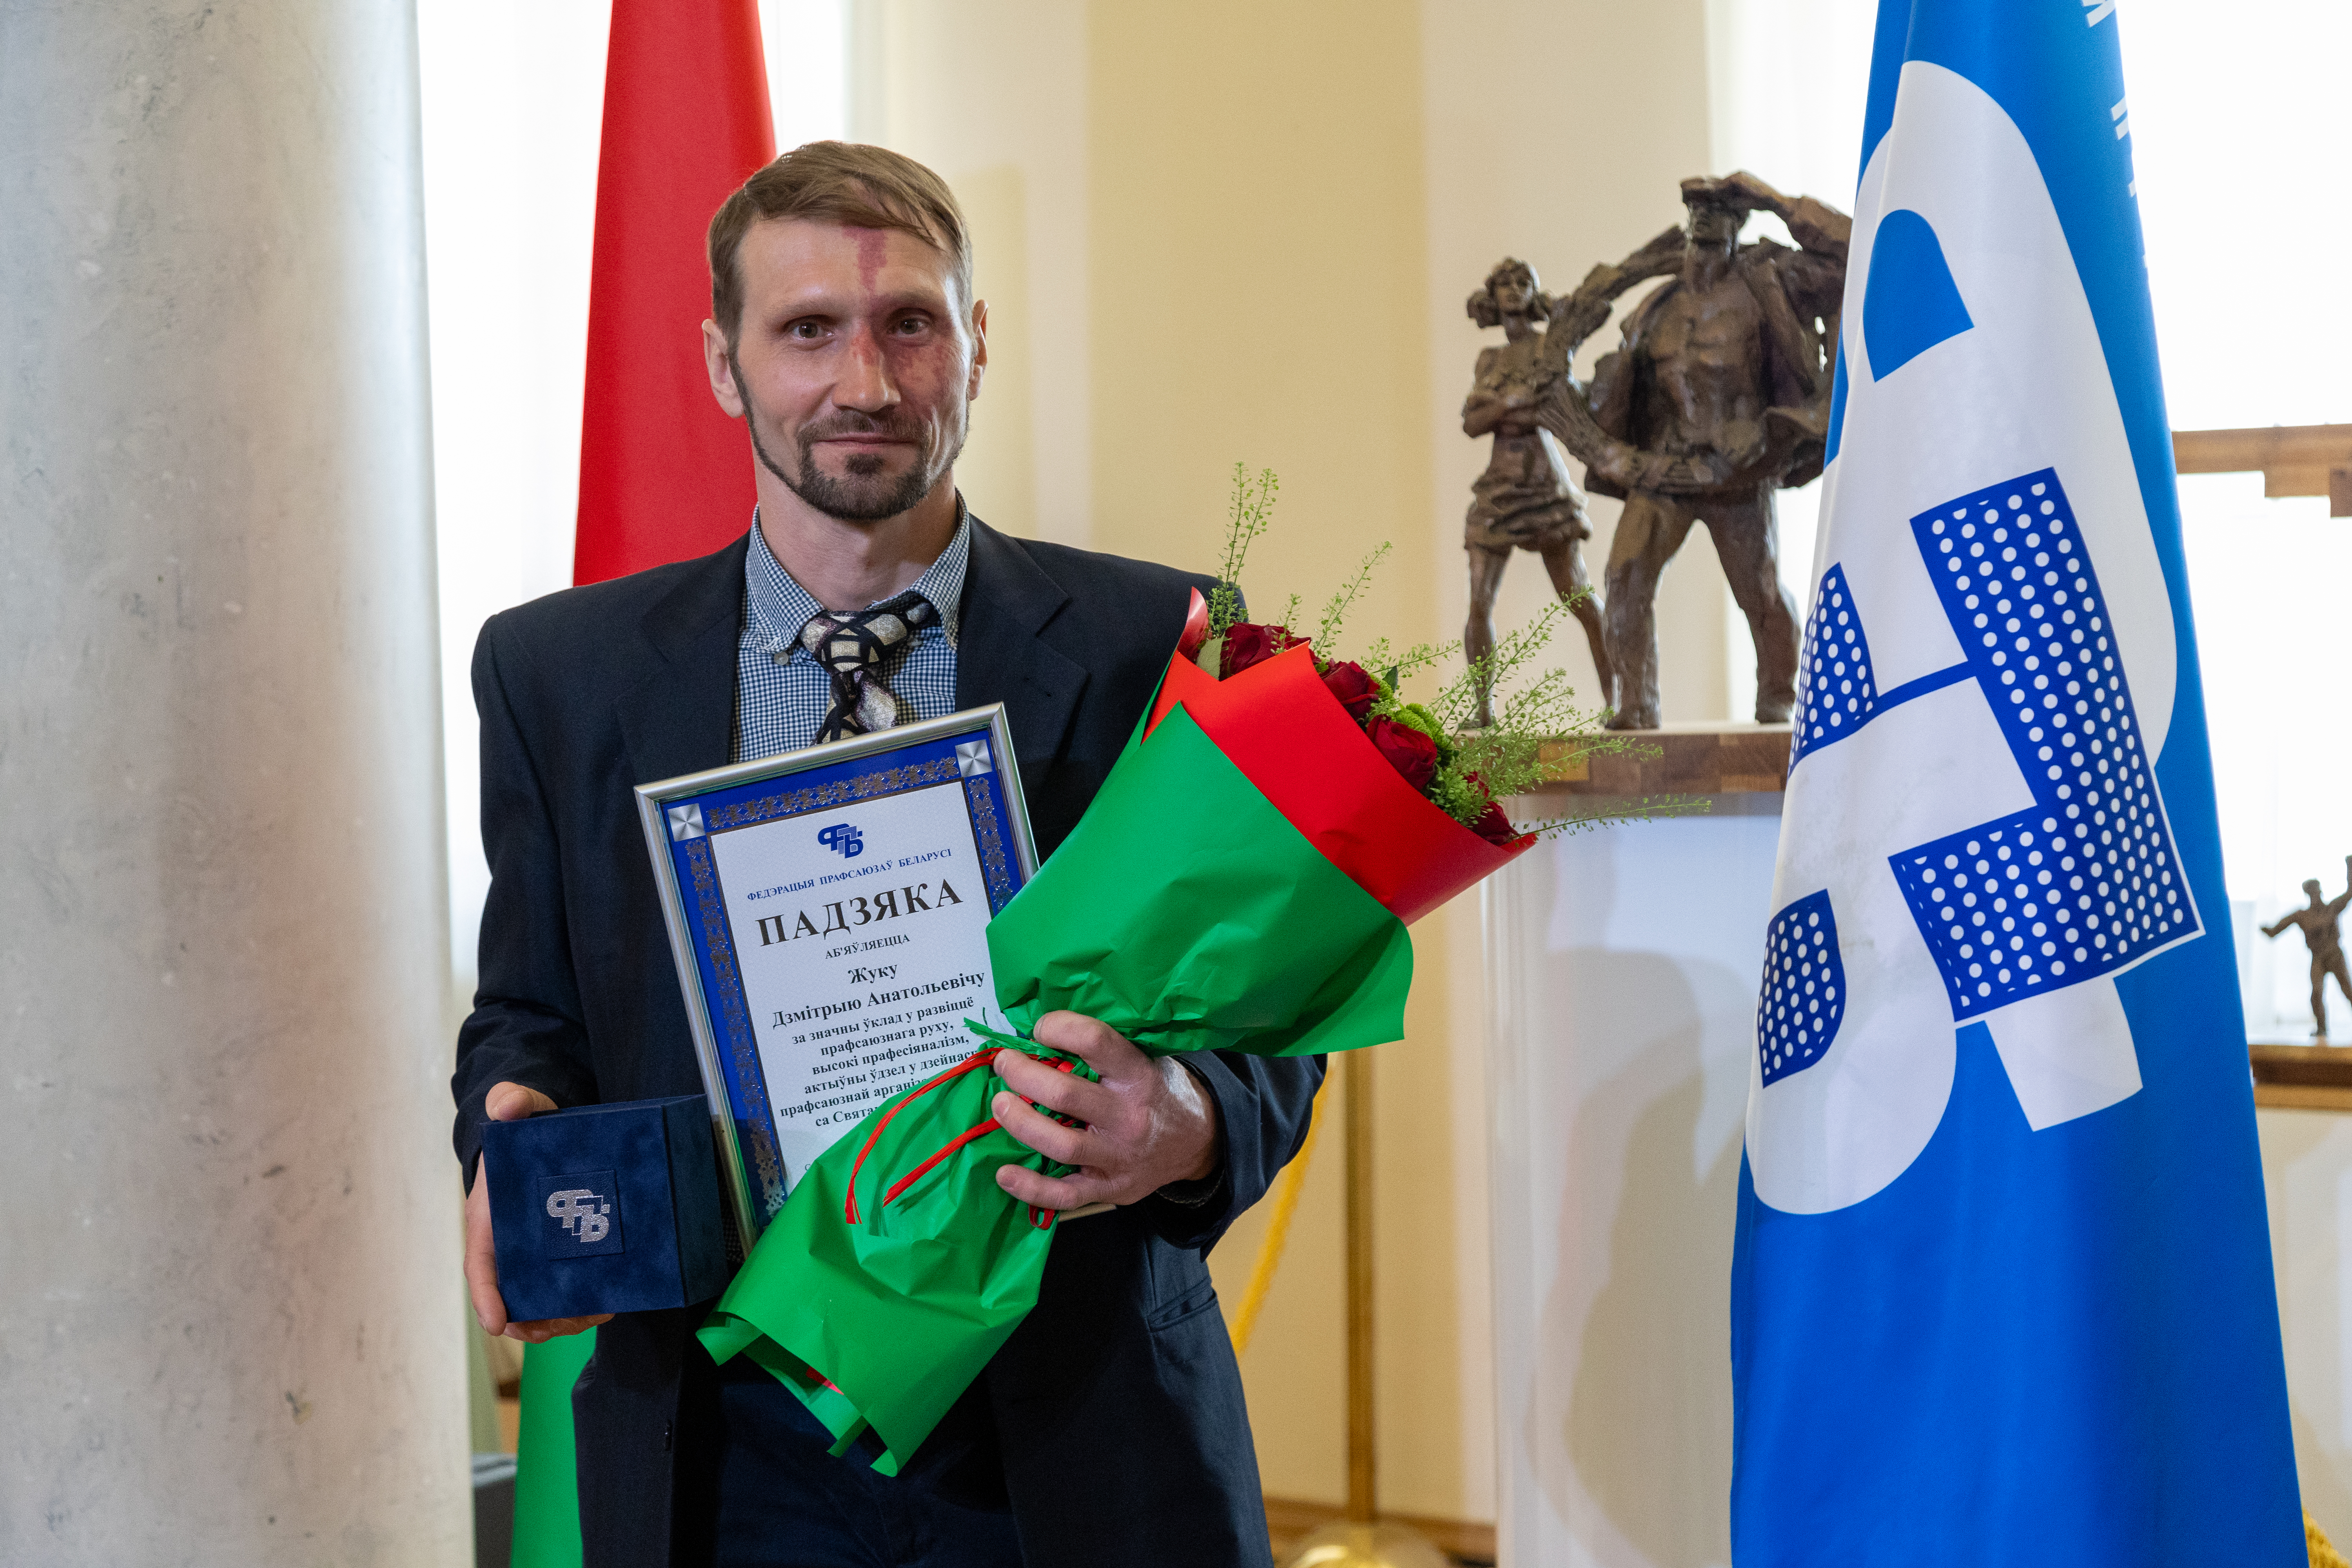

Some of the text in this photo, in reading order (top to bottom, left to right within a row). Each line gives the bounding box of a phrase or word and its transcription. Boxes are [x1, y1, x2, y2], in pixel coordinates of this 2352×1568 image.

[747, 849, 952, 900] ФЕДЭРАЦЫЯ ПРАФСАЮЗАЎ БЕЛАРУСІ
[755, 878, 963, 946] ПАДЗЯКА
[825, 934, 910, 959] АБ'ЯЎЛЯЕЦЦА
[848, 964, 898, 984] Жуку
[772, 972, 985, 1029] Дзмітрыю Анатольевічу
[792, 997, 974, 1044] за значны ўклад у развіццё
[812, 1036, 969, 1075] высокі прафесіяналізм,
[820, 1021, 954, 1057] прафсаюзнага руху,
[804, 1073, 867, 1094] актыўны
[870, 1065, 906, 1083] ўдзел
[909, 1063, 916, 1075] у
[780, 1088, 870, 1118] прафсаюзнай
[815, 1107, 878, 1127] са Свята
